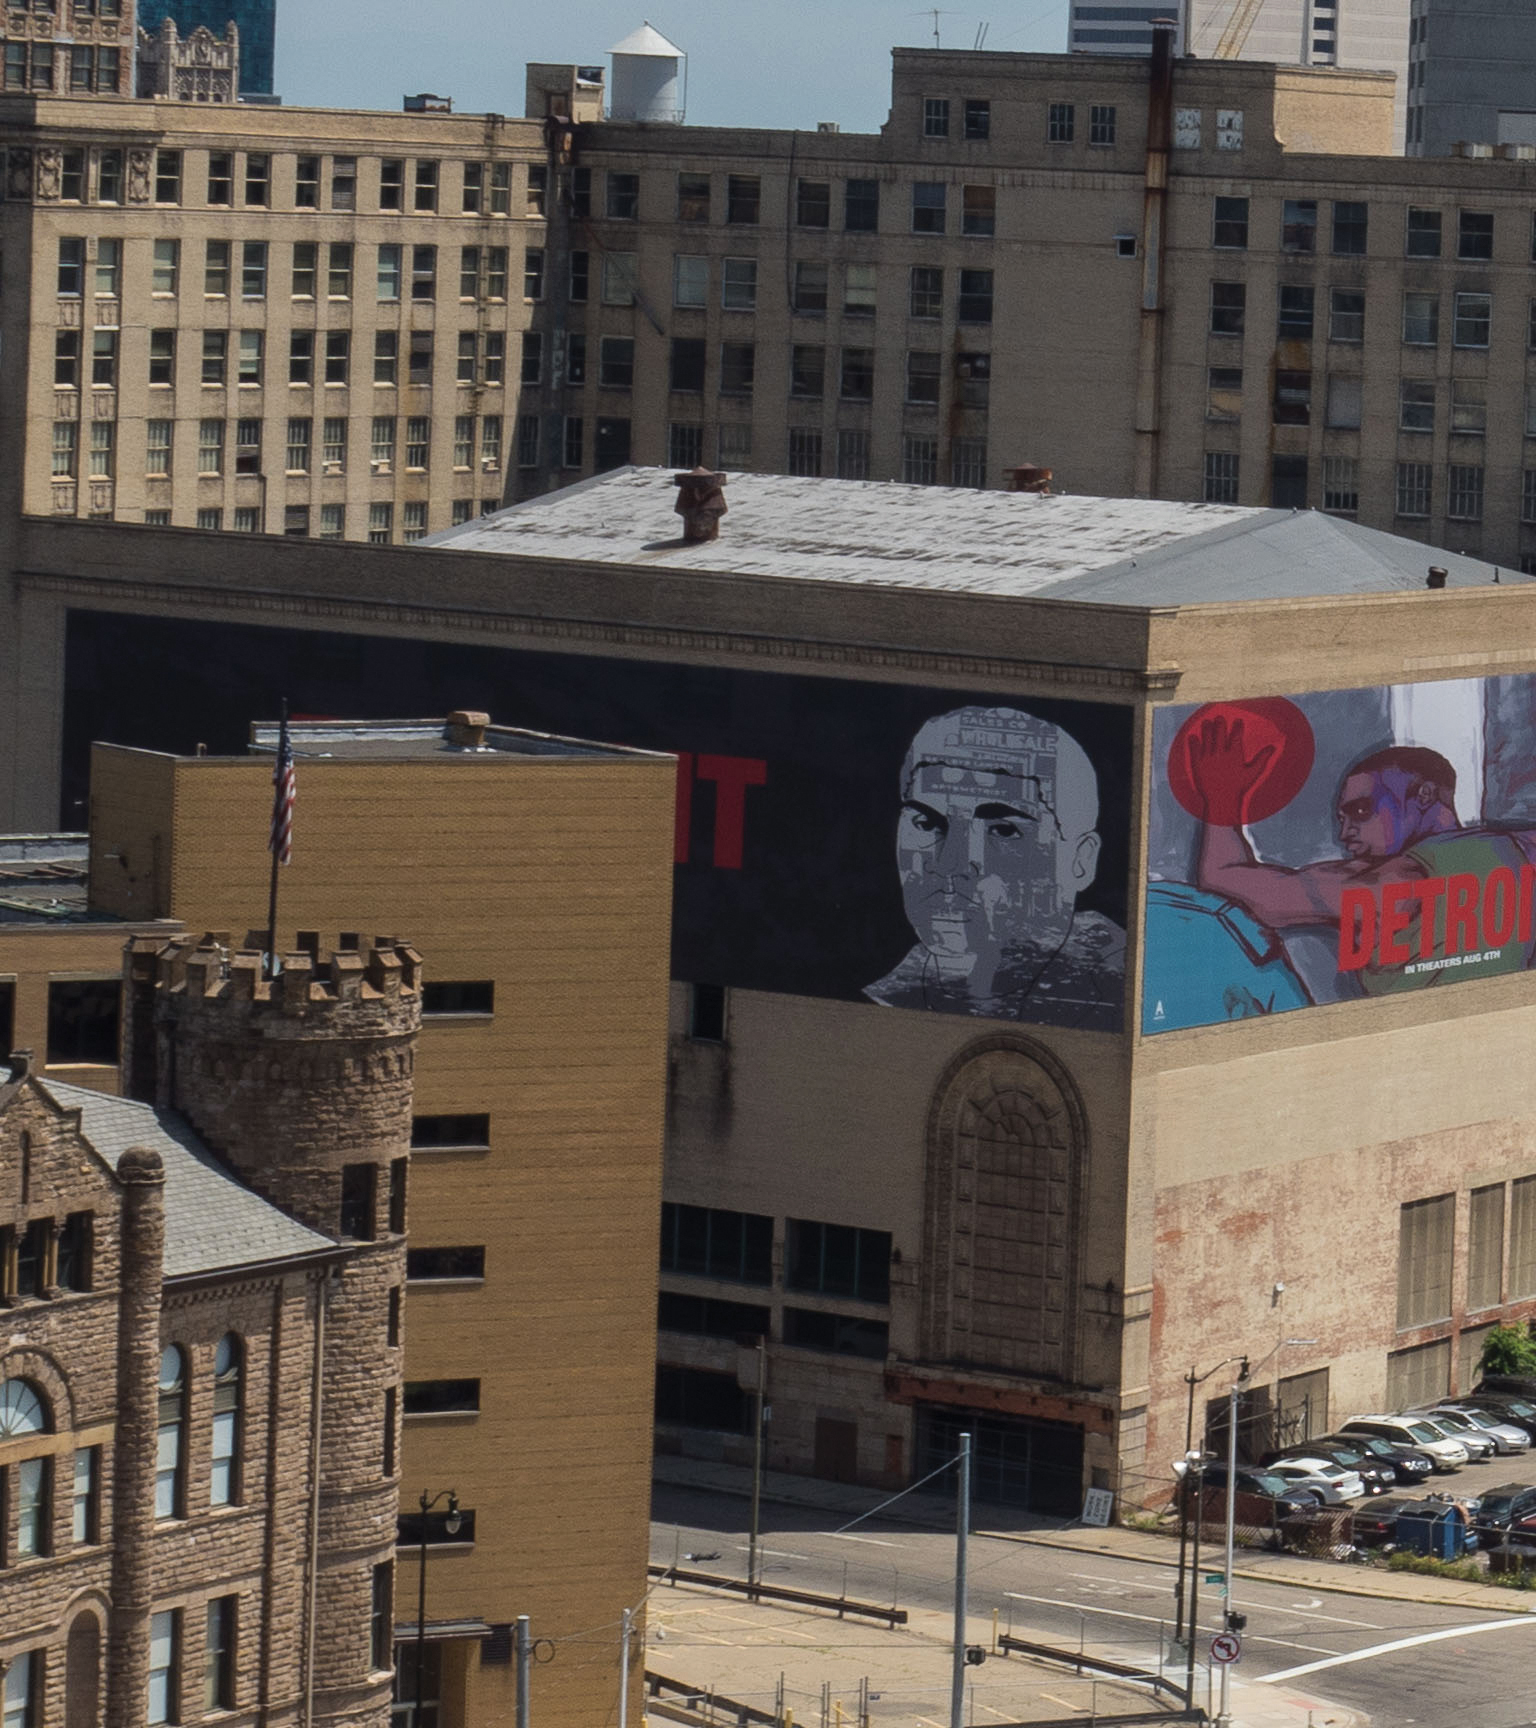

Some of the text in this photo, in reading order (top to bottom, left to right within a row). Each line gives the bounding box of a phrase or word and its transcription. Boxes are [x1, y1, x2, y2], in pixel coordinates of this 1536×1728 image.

[1405, 950, 1501, 975] IN THEATERS AUG 4TH
